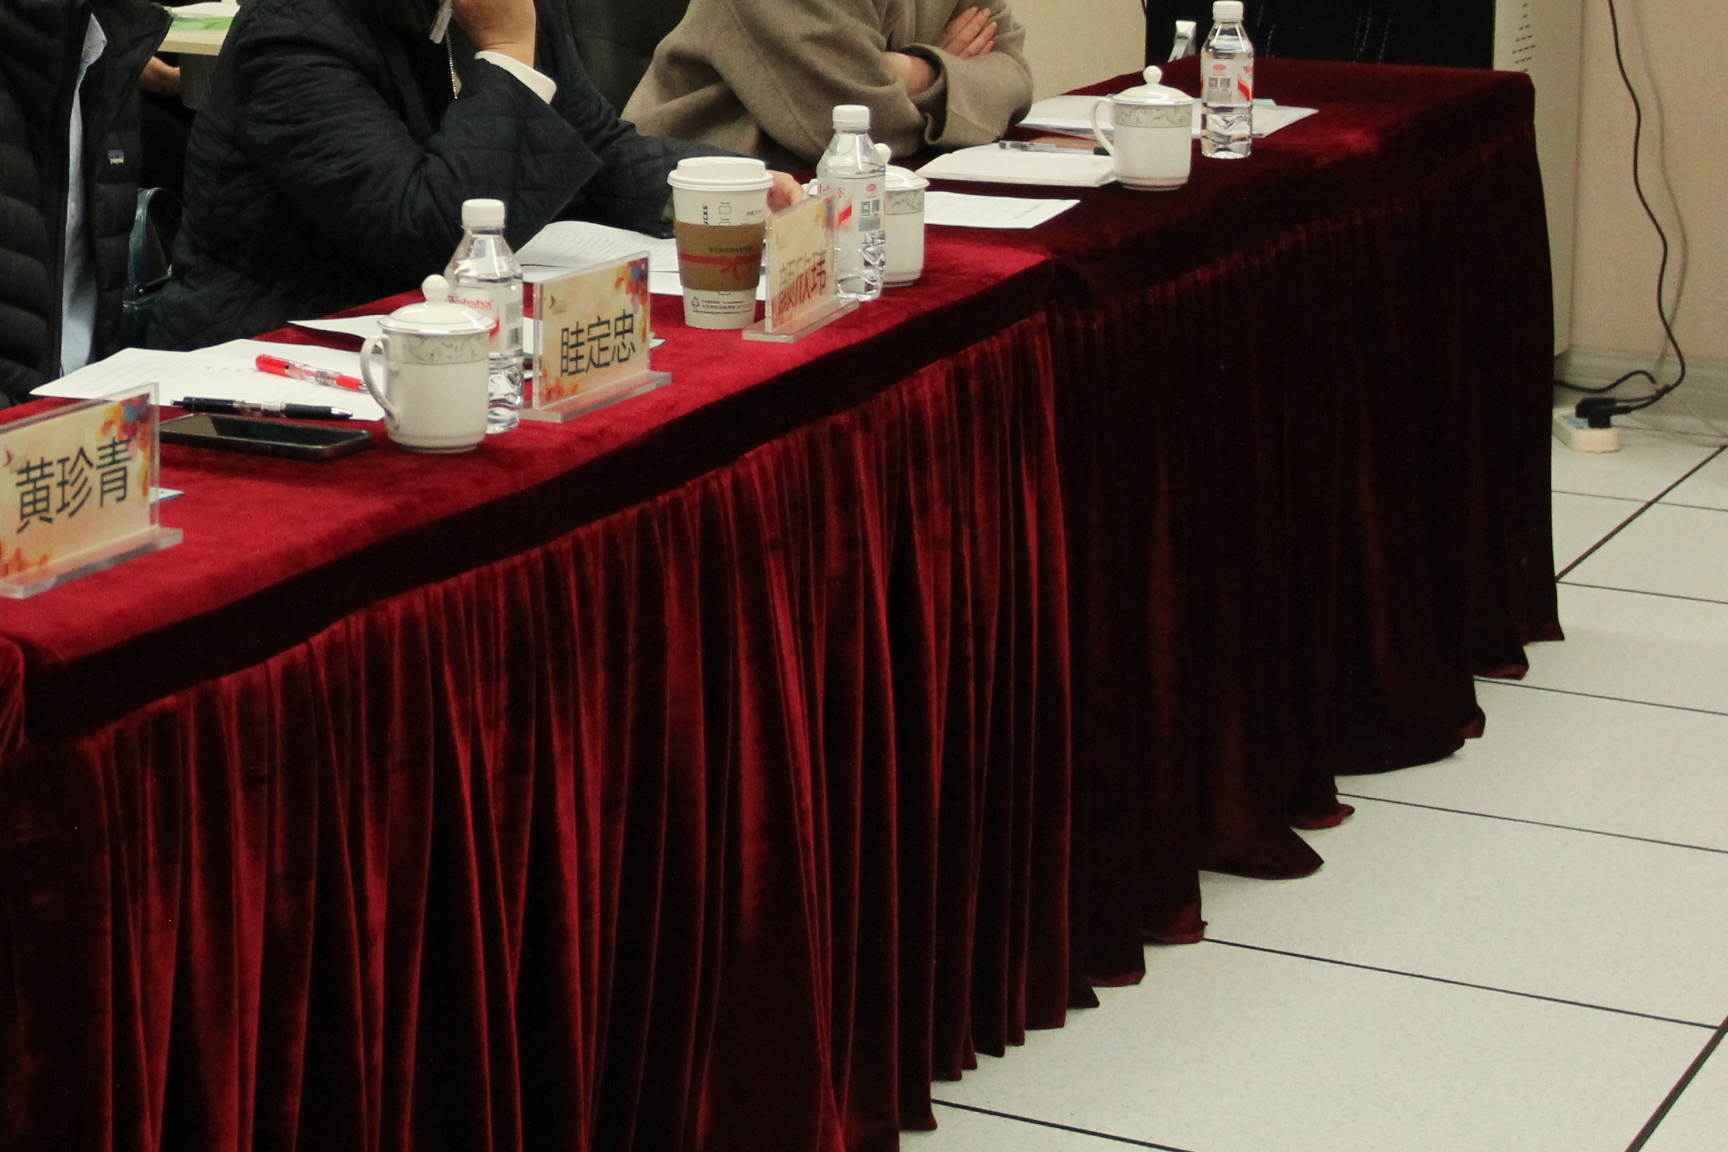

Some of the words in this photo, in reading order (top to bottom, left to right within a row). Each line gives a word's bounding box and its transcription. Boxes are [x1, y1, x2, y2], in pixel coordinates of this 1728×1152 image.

[560, 308, 636, 378] 眭定忠
[15, 436, 132, 534] 黄珍青
